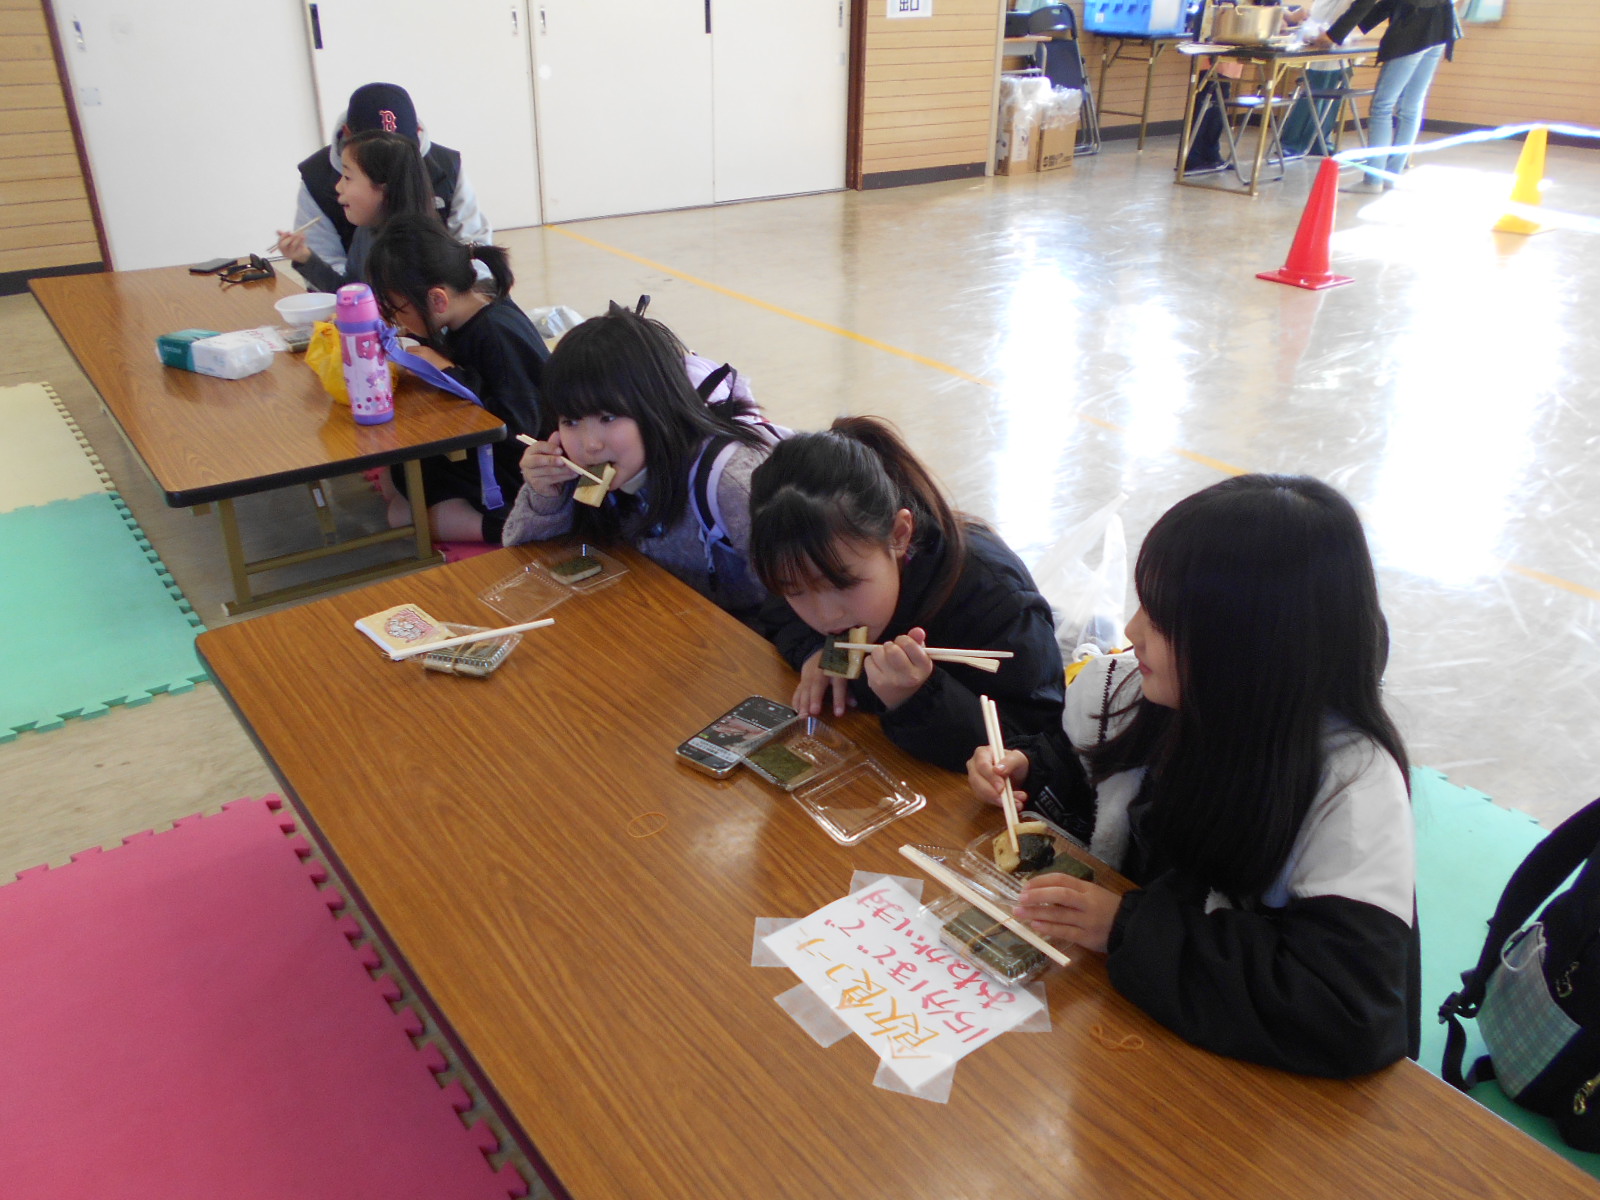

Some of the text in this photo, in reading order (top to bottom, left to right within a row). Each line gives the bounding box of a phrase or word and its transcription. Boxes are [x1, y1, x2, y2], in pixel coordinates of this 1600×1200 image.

[379, 110, 397, 132] B
[795, 926, 941, 1060] 飲食コーナー
[824, 918, 990, 1043] 15分ほどで
[856, 888, 1017, 1012] おねがいします
